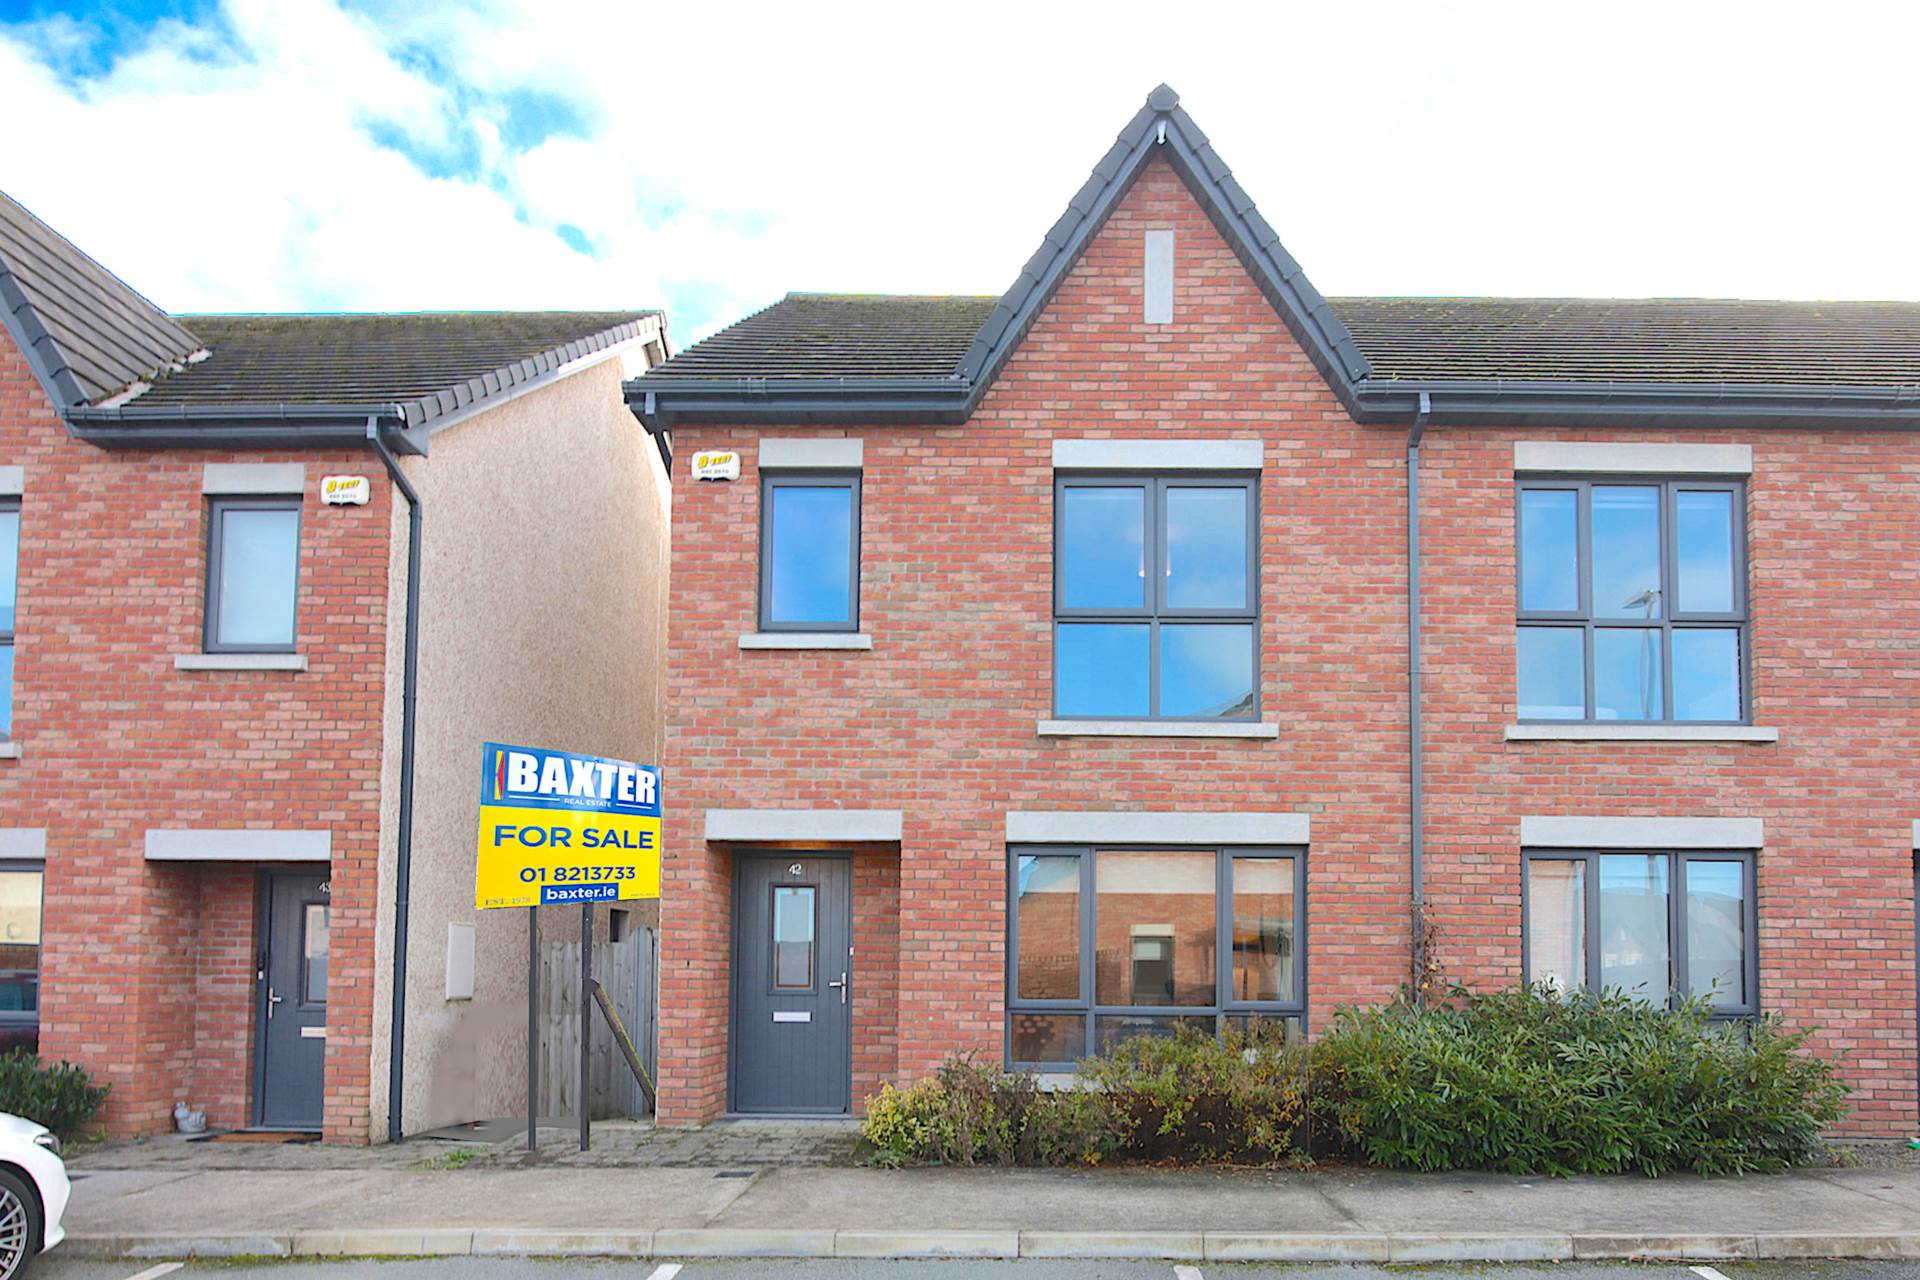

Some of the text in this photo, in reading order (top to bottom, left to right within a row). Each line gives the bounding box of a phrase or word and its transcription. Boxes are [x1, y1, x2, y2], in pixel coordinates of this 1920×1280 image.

[507, 752, 656, 804] BAXTER
[564, 798, 612, 808] REAL ESTATE
[494, 825, 654, 849] FOR SALE
[519, 866, 636, 882] 01 8213733
[788, 863, 802, 875] 42
[546, 886, 616, 900] baxter.ie
